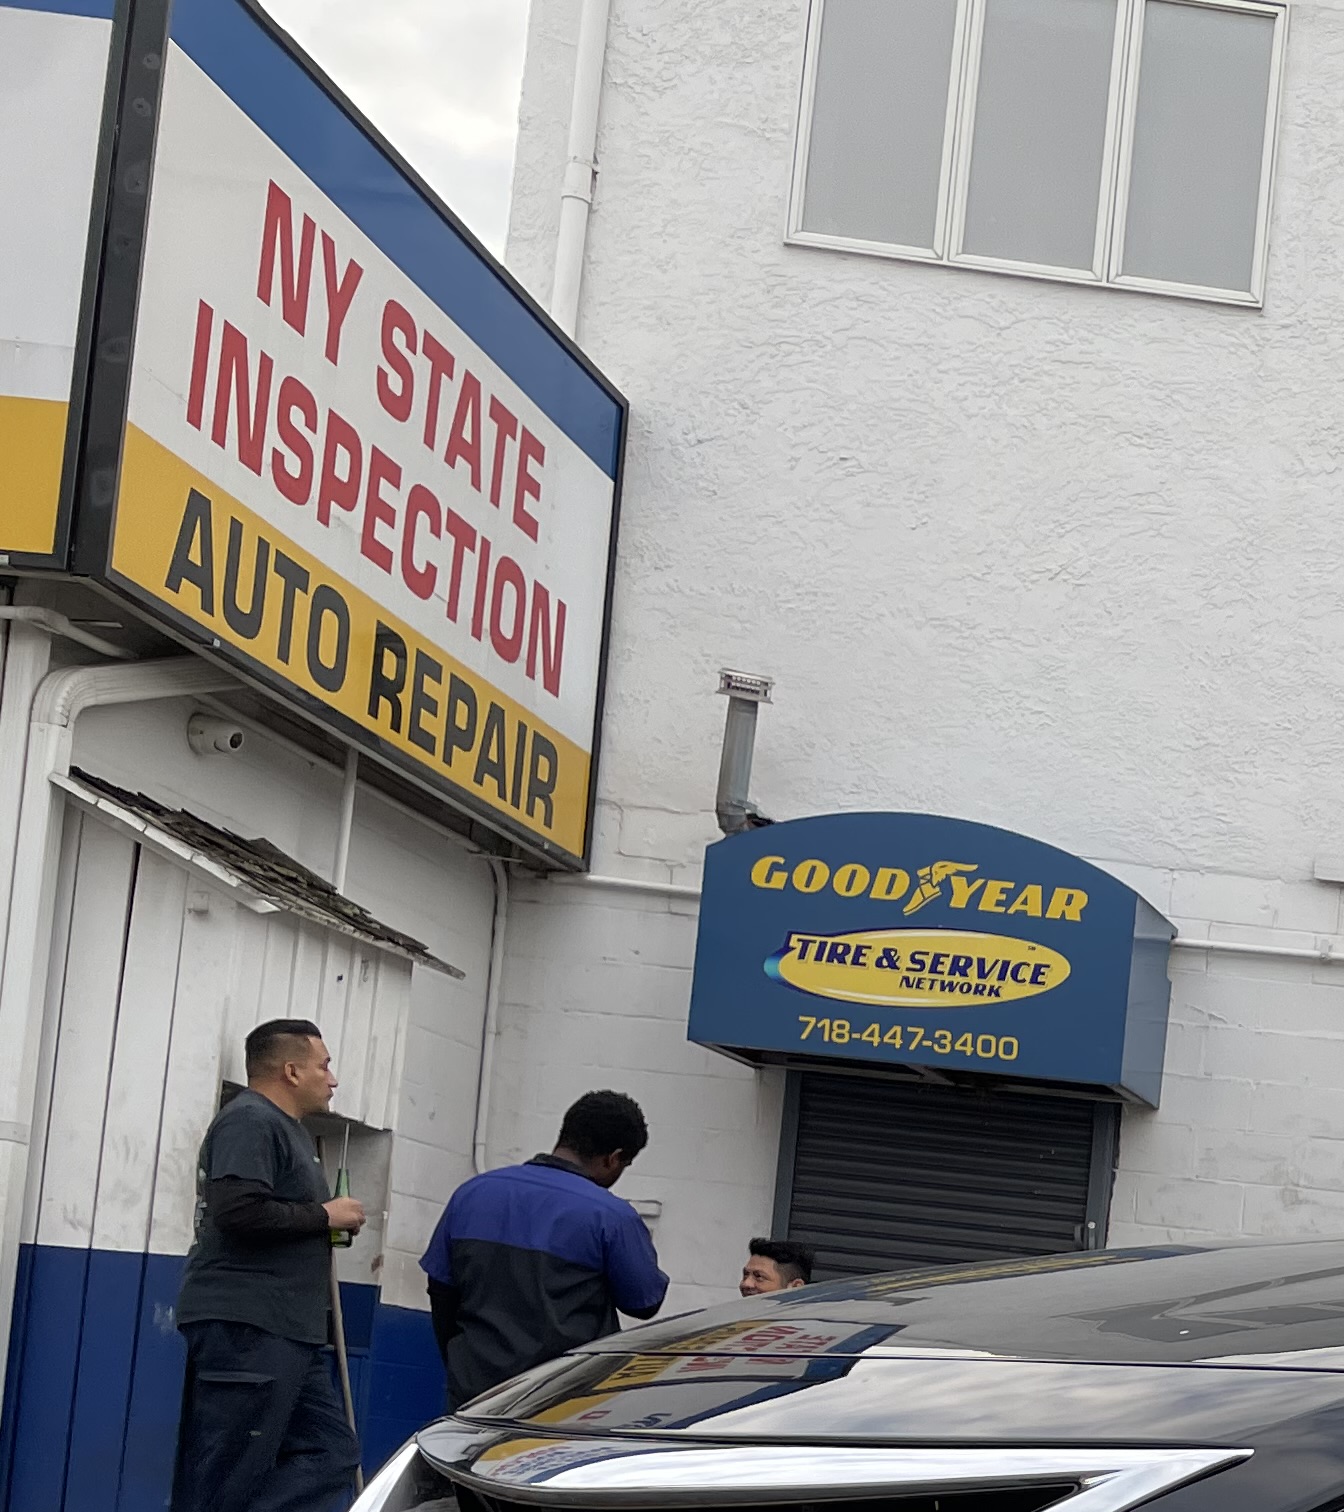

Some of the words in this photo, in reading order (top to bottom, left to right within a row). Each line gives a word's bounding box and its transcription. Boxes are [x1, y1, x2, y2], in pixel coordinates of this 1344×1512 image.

[257, 179, 364, 367] NY
[376, 299, 546, 544] STATE
[187, 299, 567, 698] INSPECTION
[165, 487, 349, 693] AUTO
[369, 620, 559, 830] REPAIR
[795, 937, 872, 967] TIRE
[874, 947, 901, 971] &
[905, 950, 1051, 987] SERVICE
[798, 1015, 1019, 1061] 718-447-3400
[899, 975, 1003, 998] NETWORK
